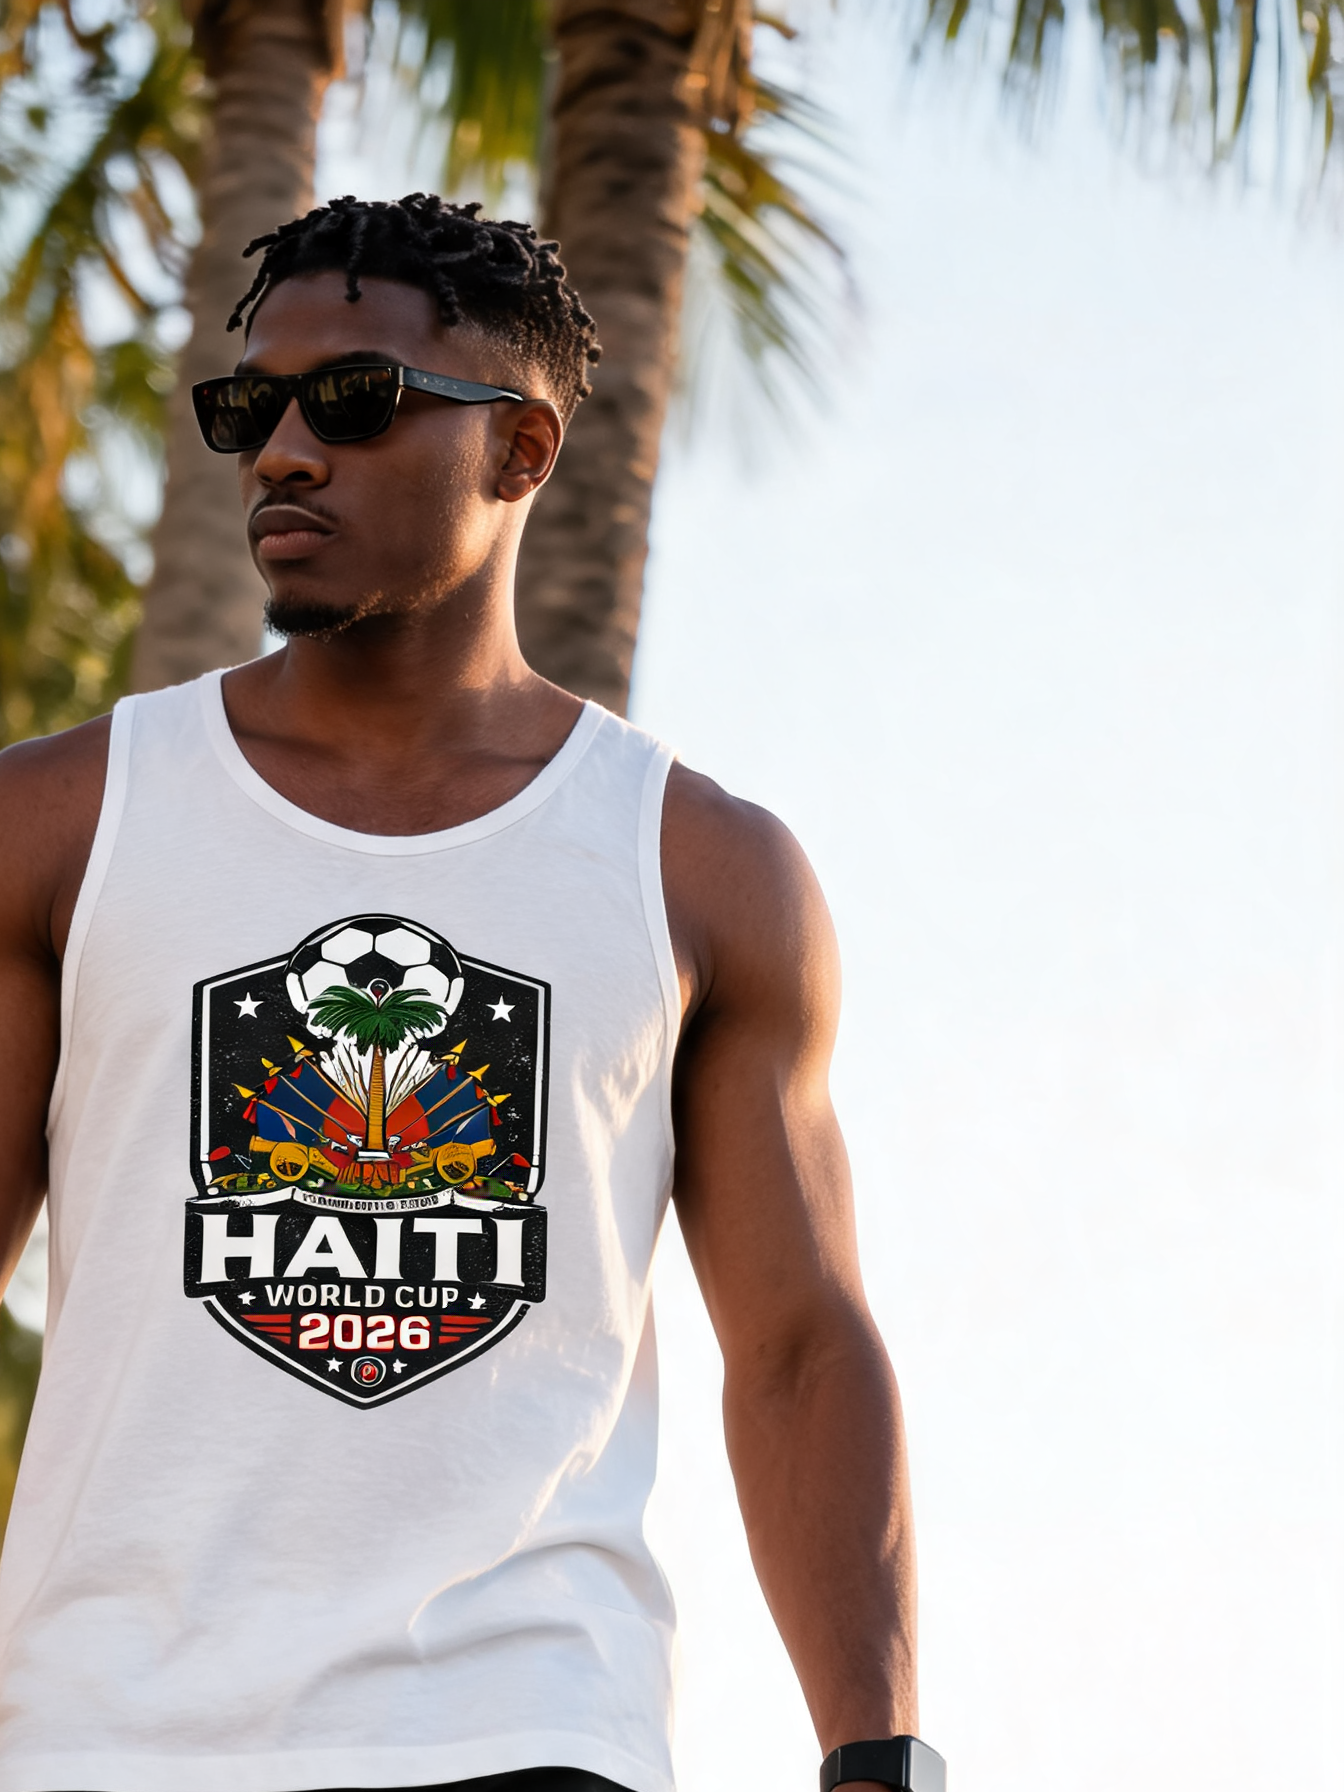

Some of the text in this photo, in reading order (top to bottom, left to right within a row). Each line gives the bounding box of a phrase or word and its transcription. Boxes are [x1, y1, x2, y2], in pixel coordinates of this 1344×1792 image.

[197, 1214, 527, 1287] HAITI
[265, 1284, 460, 1309] WORLD CUP
[298, 1313, 431, 1351] 2026
